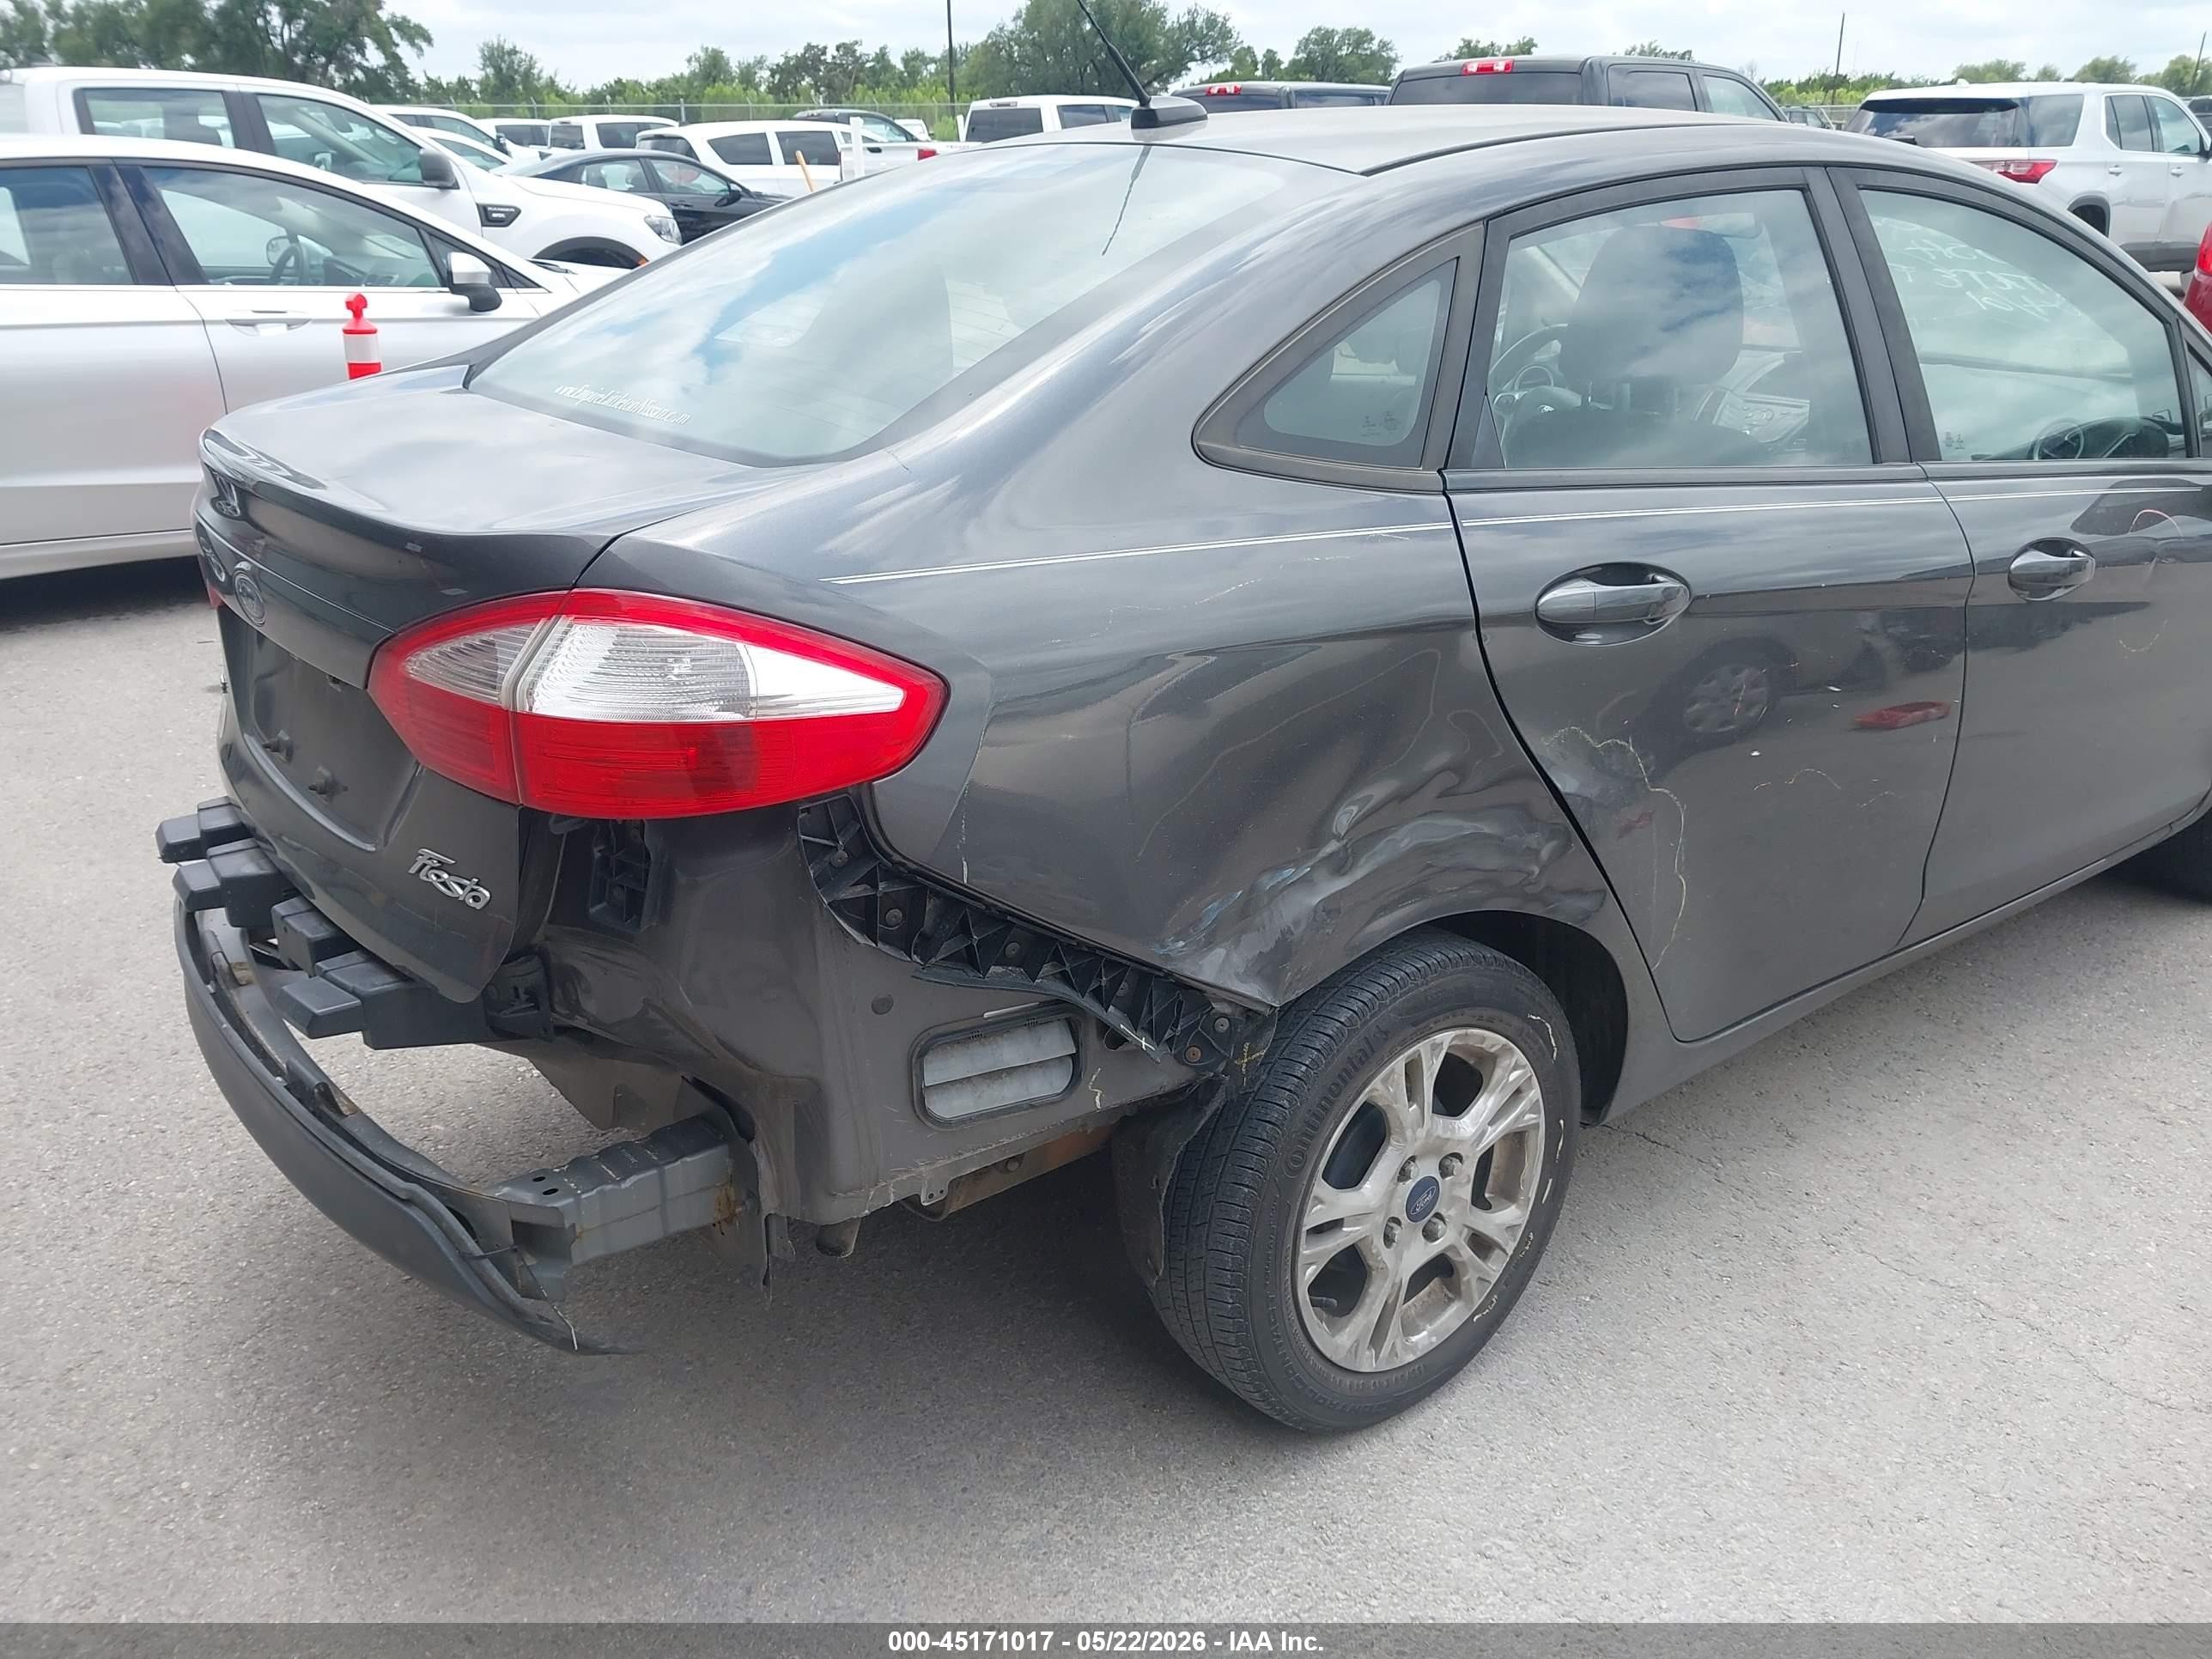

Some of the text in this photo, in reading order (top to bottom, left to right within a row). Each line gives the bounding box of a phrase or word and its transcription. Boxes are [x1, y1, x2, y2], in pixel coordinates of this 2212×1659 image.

[408, 848, 491, 910] Fiesta
[1282, 1036, 1377, 1179] Continental
[1413, 1188, 1433, 1212] Ford
